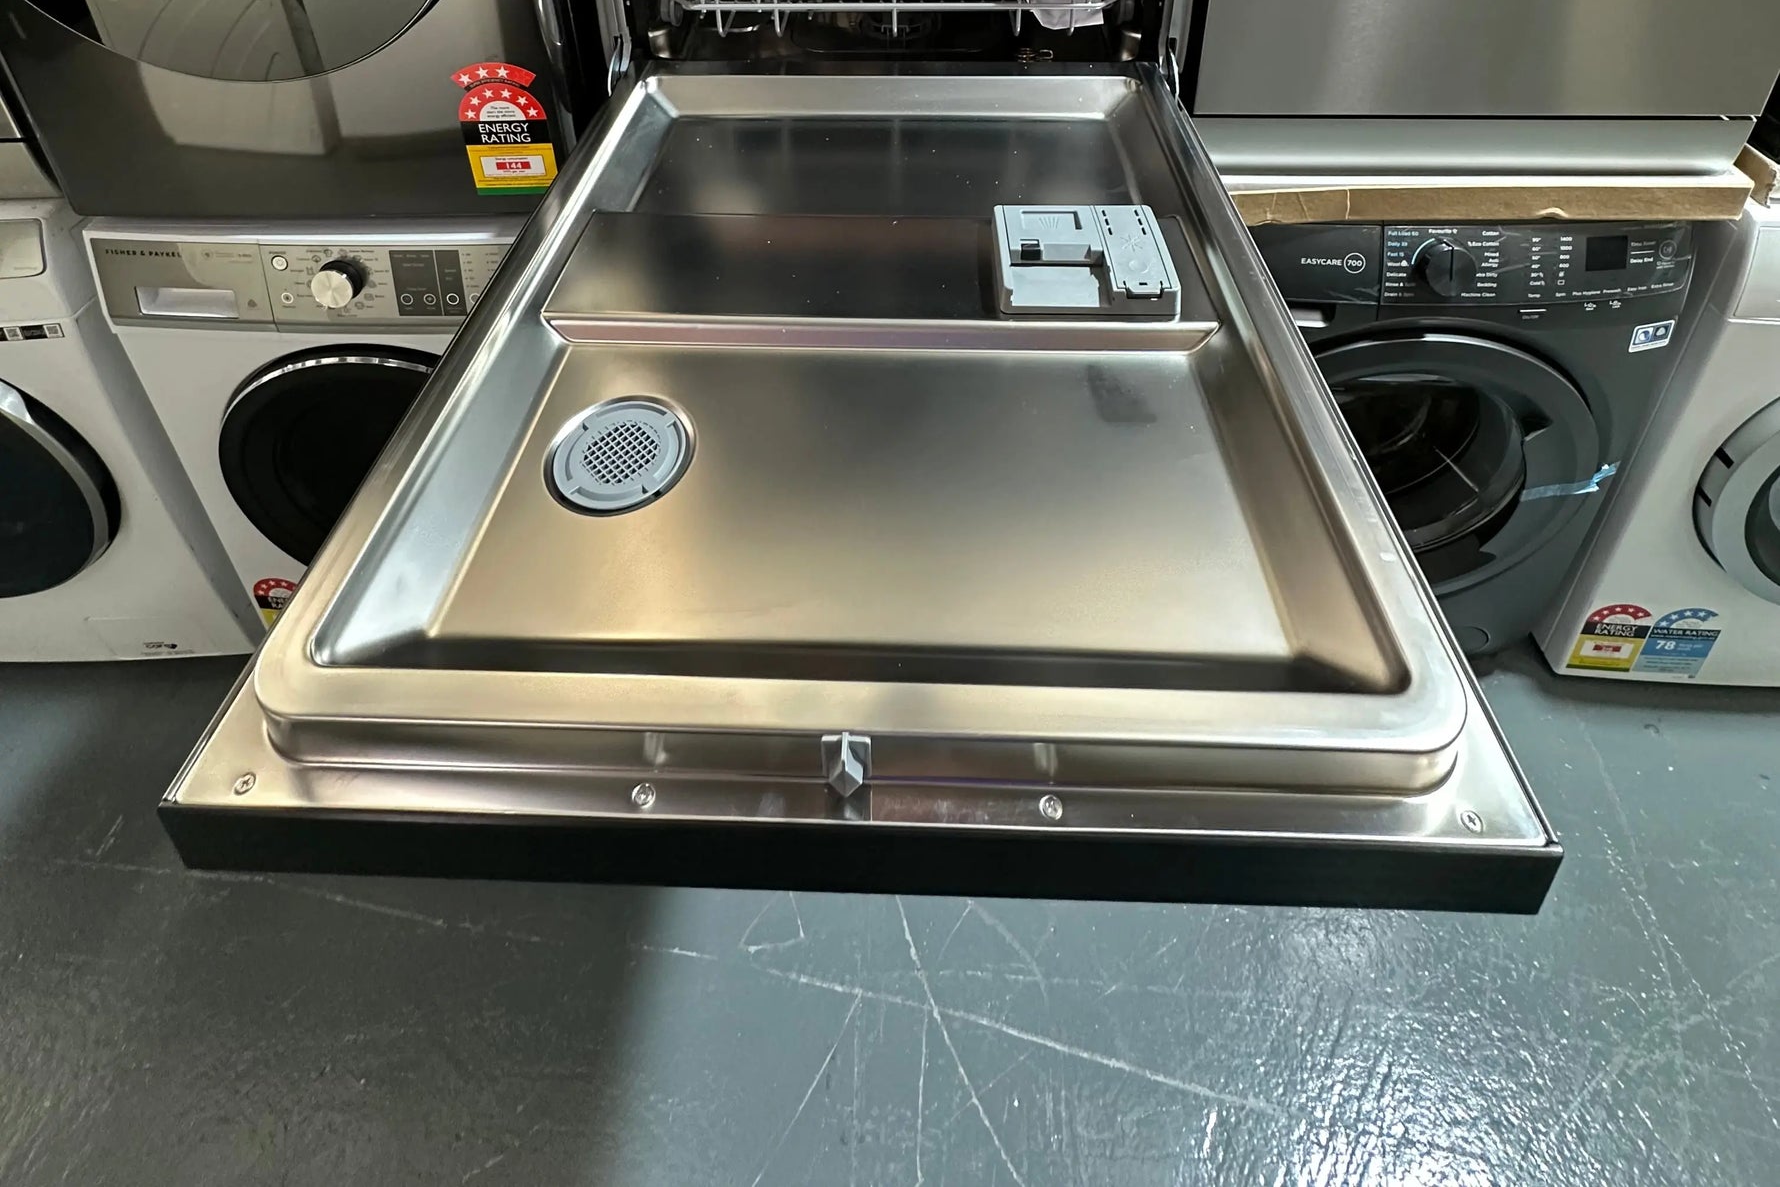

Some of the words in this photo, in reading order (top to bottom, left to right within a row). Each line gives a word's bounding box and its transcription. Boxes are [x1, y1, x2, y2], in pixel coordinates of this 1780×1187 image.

[478, 122, 529, 133] ENERGY
[480, 133, 531, 144] RATING
[505, 162, 522, 170] 144
[105, 248, 137, 256] FISHER
[149, 250, 183, 259] PAYKEL
[1301, 257, 1343, 266] EASYCARE
[1347, 259, 1363, 267] 700
[1596, 623, 1639, 631] ENERGY
[1594, 629, 1635, 637] RATING
[1653, 628, 1685, 636] WATER
[1685, 629, 1719, 637] RATING
[1655, 640, 1677, 651] 78
